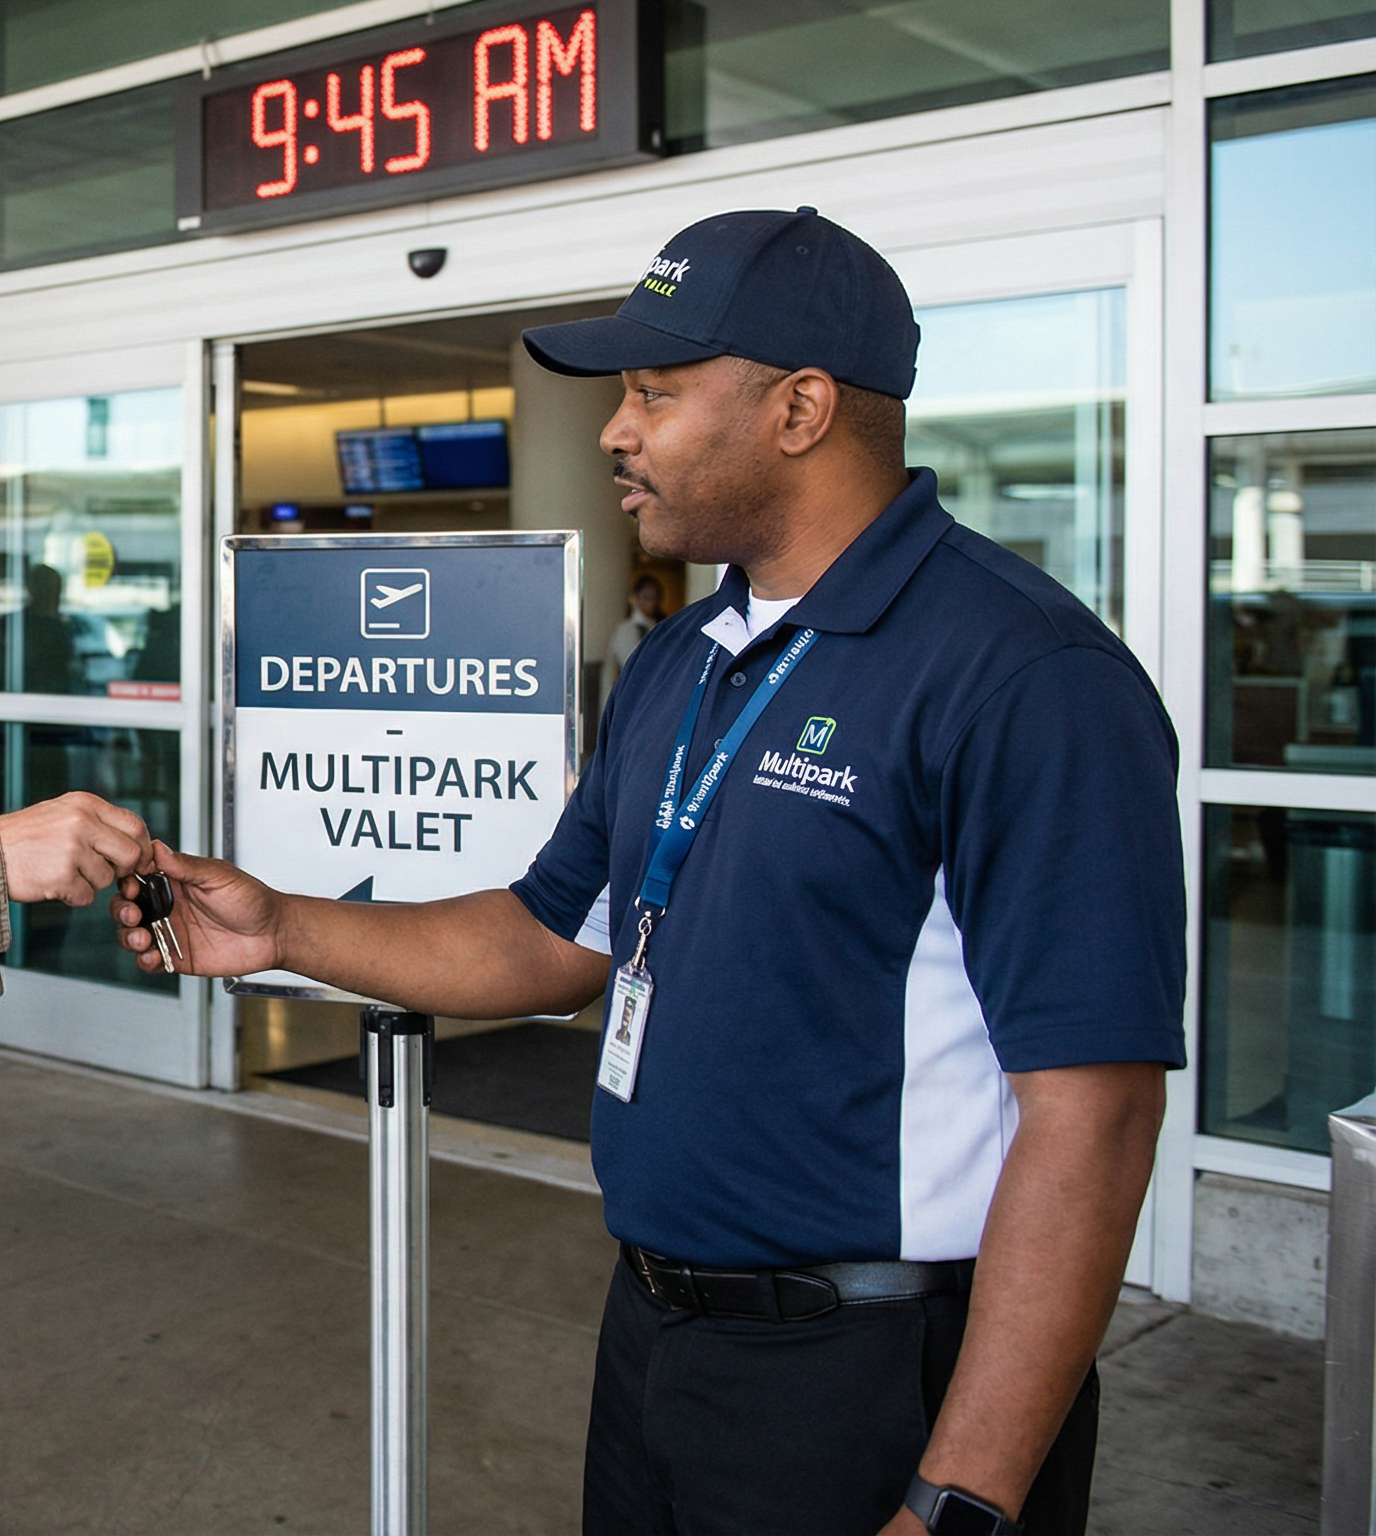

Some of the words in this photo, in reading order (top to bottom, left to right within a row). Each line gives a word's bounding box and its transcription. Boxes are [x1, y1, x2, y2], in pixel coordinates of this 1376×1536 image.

[252, 47, 430, 198] 9:45
[475, 9, 595, 152] AM
[260, 656, 539, 697] DEPARTURES
[801, 724, 829, 748] M
[260, 752, 539, 801] MULTIPARK
[758, 750, 859, 793] Multipark
[320, 807, 473, 853] VALET
